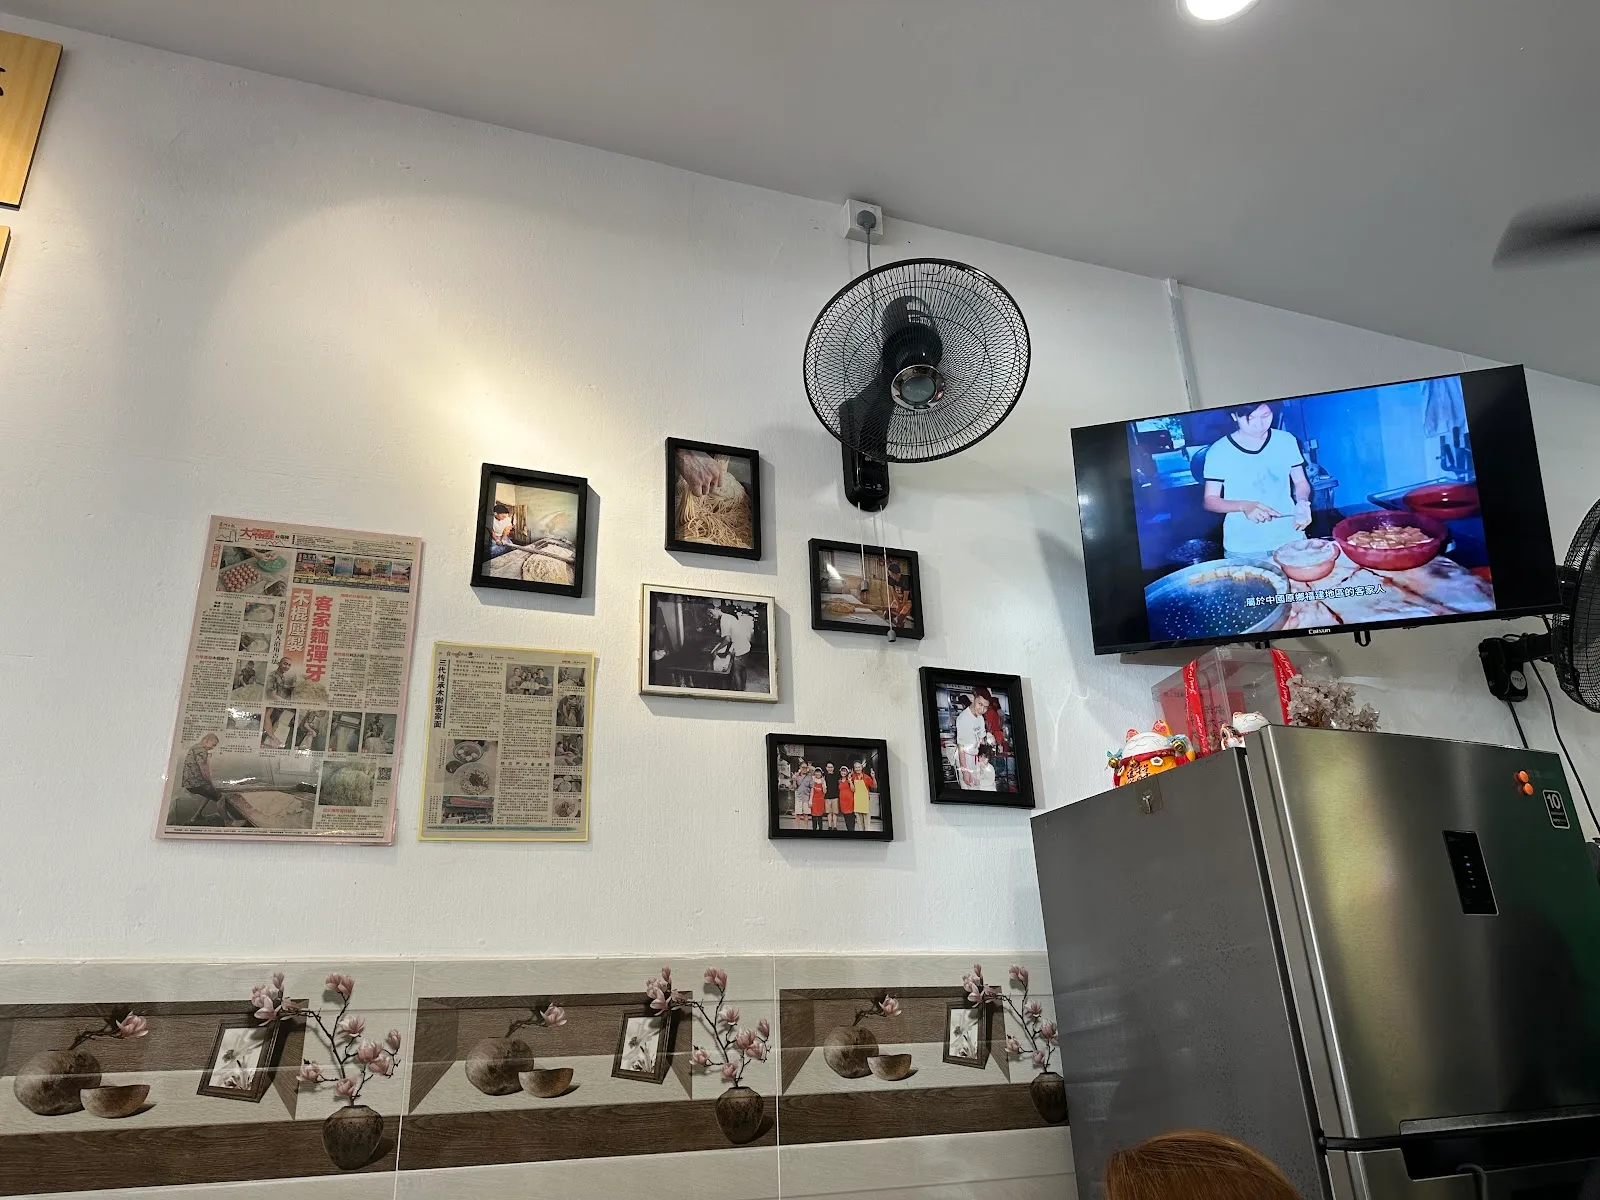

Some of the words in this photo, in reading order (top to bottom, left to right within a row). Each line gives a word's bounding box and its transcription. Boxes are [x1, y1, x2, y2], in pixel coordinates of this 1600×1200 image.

[1245, 584, 1386, 607] 屬於中國原鄉福建地區的客家人
[286, 590, 311, 652] 木棍壓製
[304, 596, 333, 683] 客家麵彈牙
[1546, 793, 1561, 809] 10
